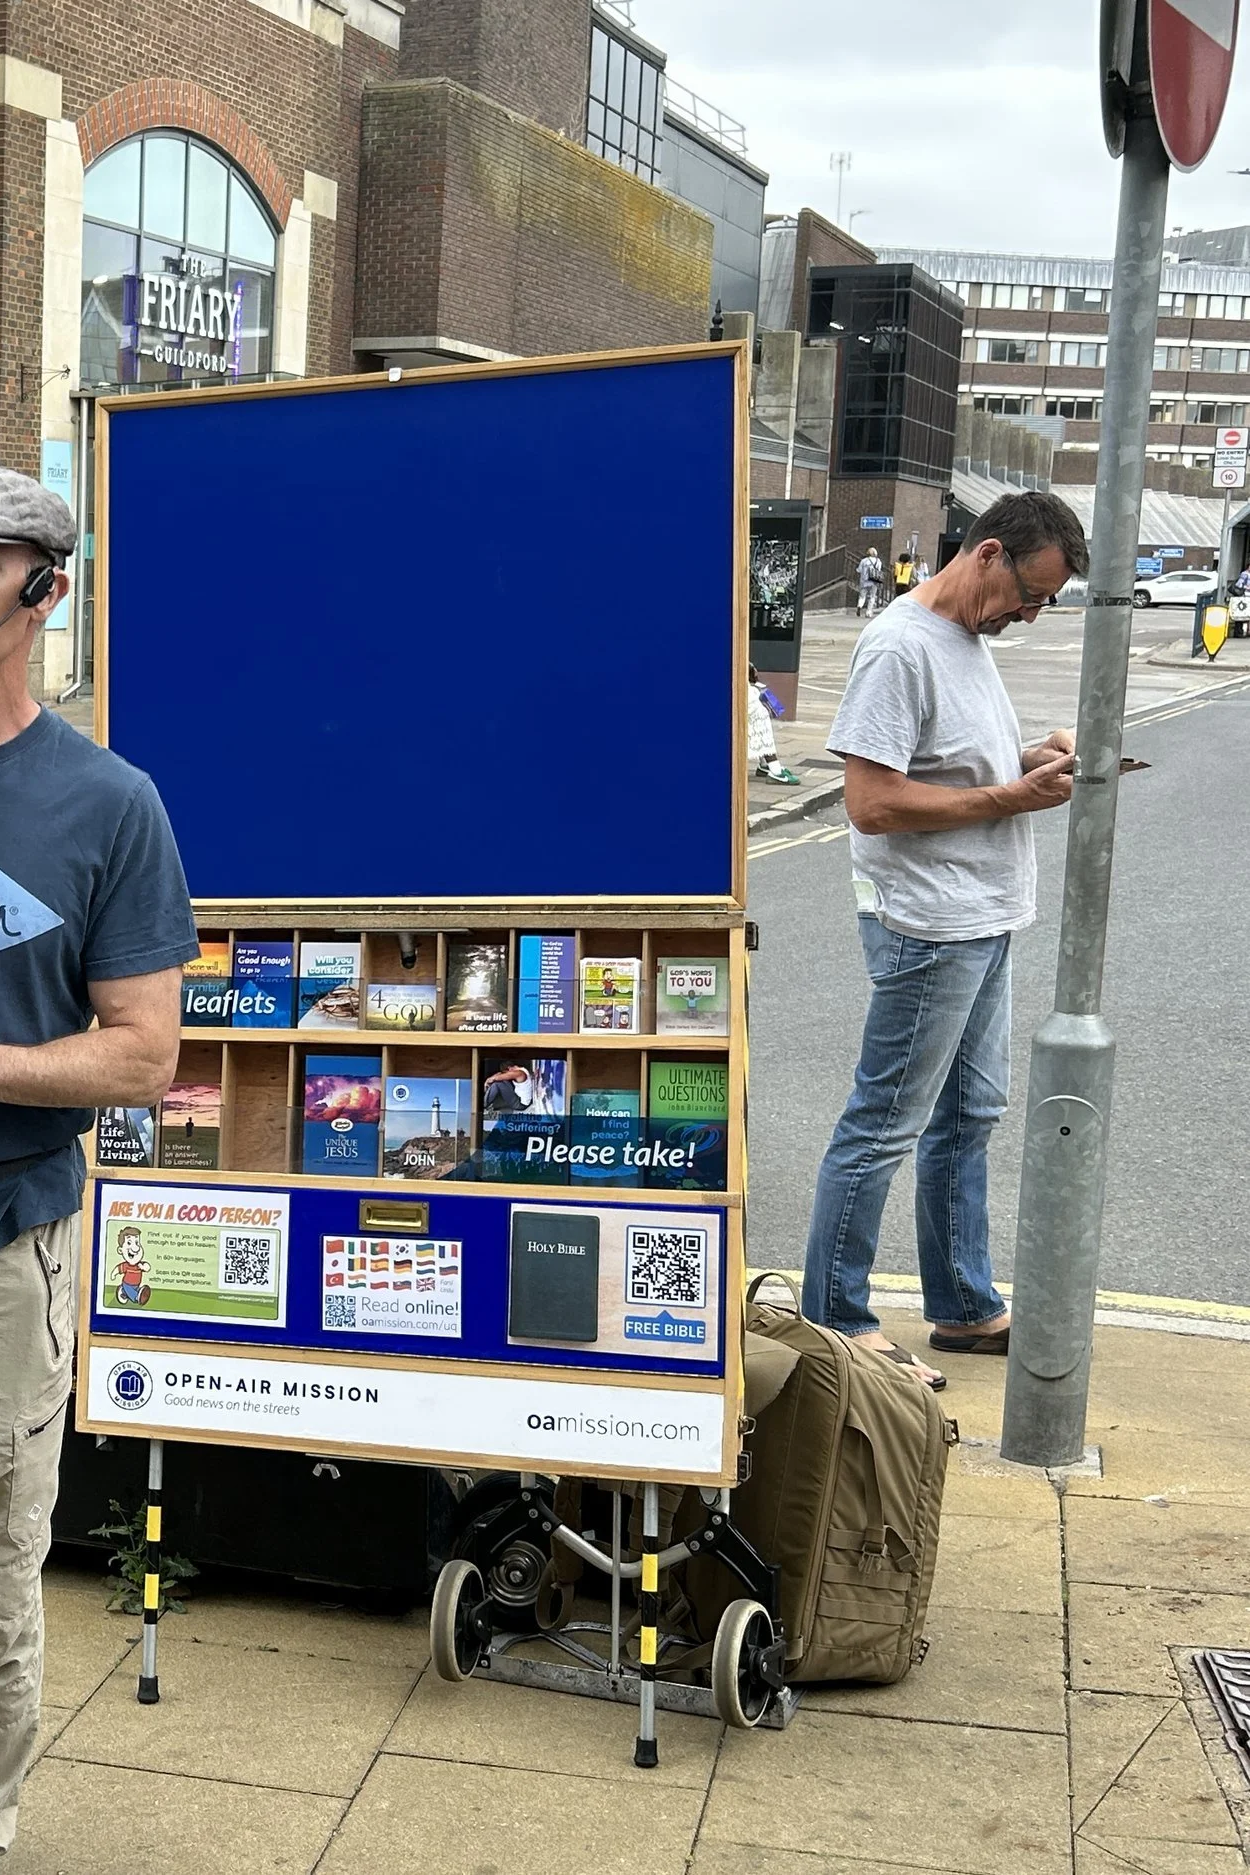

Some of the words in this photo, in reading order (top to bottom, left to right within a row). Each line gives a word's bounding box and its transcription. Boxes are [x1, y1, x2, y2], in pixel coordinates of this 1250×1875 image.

[182, 255, 206, 278] THE
[141, 272, 240, 342] FRIARY
[154, 345, 226, 372] GUILDFORD
[238, 956, 260, 964] Good
[261, 957, 291, 965] Enough
[335, 957, 352, 965] you
[309, 966, 351, 974] consider
[670, 978, 685, 986] TO
[690, 978, 712, 986] YOU
[186, 989, 276, 1016] leaflets
[371, 989, 386, 1008] 4
[383, 1004, 435, 1021] GOD
[493, 1013, 507, 1021] life
[539, 1005, 564, 1017] life
[476, 1023, 507, 1031] death?
[669, 1068, 726, 1086] ULTIMATE
[658, 1086, 726, 1103] QUESTIONS
[586, 1109, 610, 1118] How
[612, 1110, 630, 1119] can
[100, 1117, 111, 1125] Is
[609, 1120, 630, 1129] find
[100, 1128, 124, 1137] Life
[507, 1123, 561, 1135] Suffering?
[100, 1139, 140, 1149] Worth
[325, 1139, 358, 1148] UNIQUE
[100, 1150, 145, 1162] Living?
[324, 1147, 358, 1158] JESUS
[525, 1137, 615, 1164] Please
[623, 1142, 696, 1168] take!
[404, 1154, 435, 1166] JOHN
[108, 1201, 134, 1217] ARE
[137, 1203, 163, 1219] YOU
[164, 1204, 175, 1220] A
[177, 1205, 217, 1222] GOOD
[219, 1207, 282, 1227] PERSON?
[527, 1242, 555, 1254] HOLY
[558, 1243, 585, 1255] BIBLE
[361, 1297, 399, 1313] Read
[405, 1300, 458, 1316] online!
[362, 1318, 457, 1332] oamission.com/uq
[626, 1321, 660, 1335] FREE
[665, 1324, 704, 1338] BIBLE
[165, 1373, 271, 1394] OPEN-AIR
[284, 1382, 378, 1403] MISSION
[164, 1393, 193, 1407] Good
[196, 1398, 224, 1409] news
[226, 1402, 239, 1411] on
[243, 1401, 261, 1413] the
[264, 1403, 300, 1416] streets
[527, 1413, 700, 1441] oamission.com
